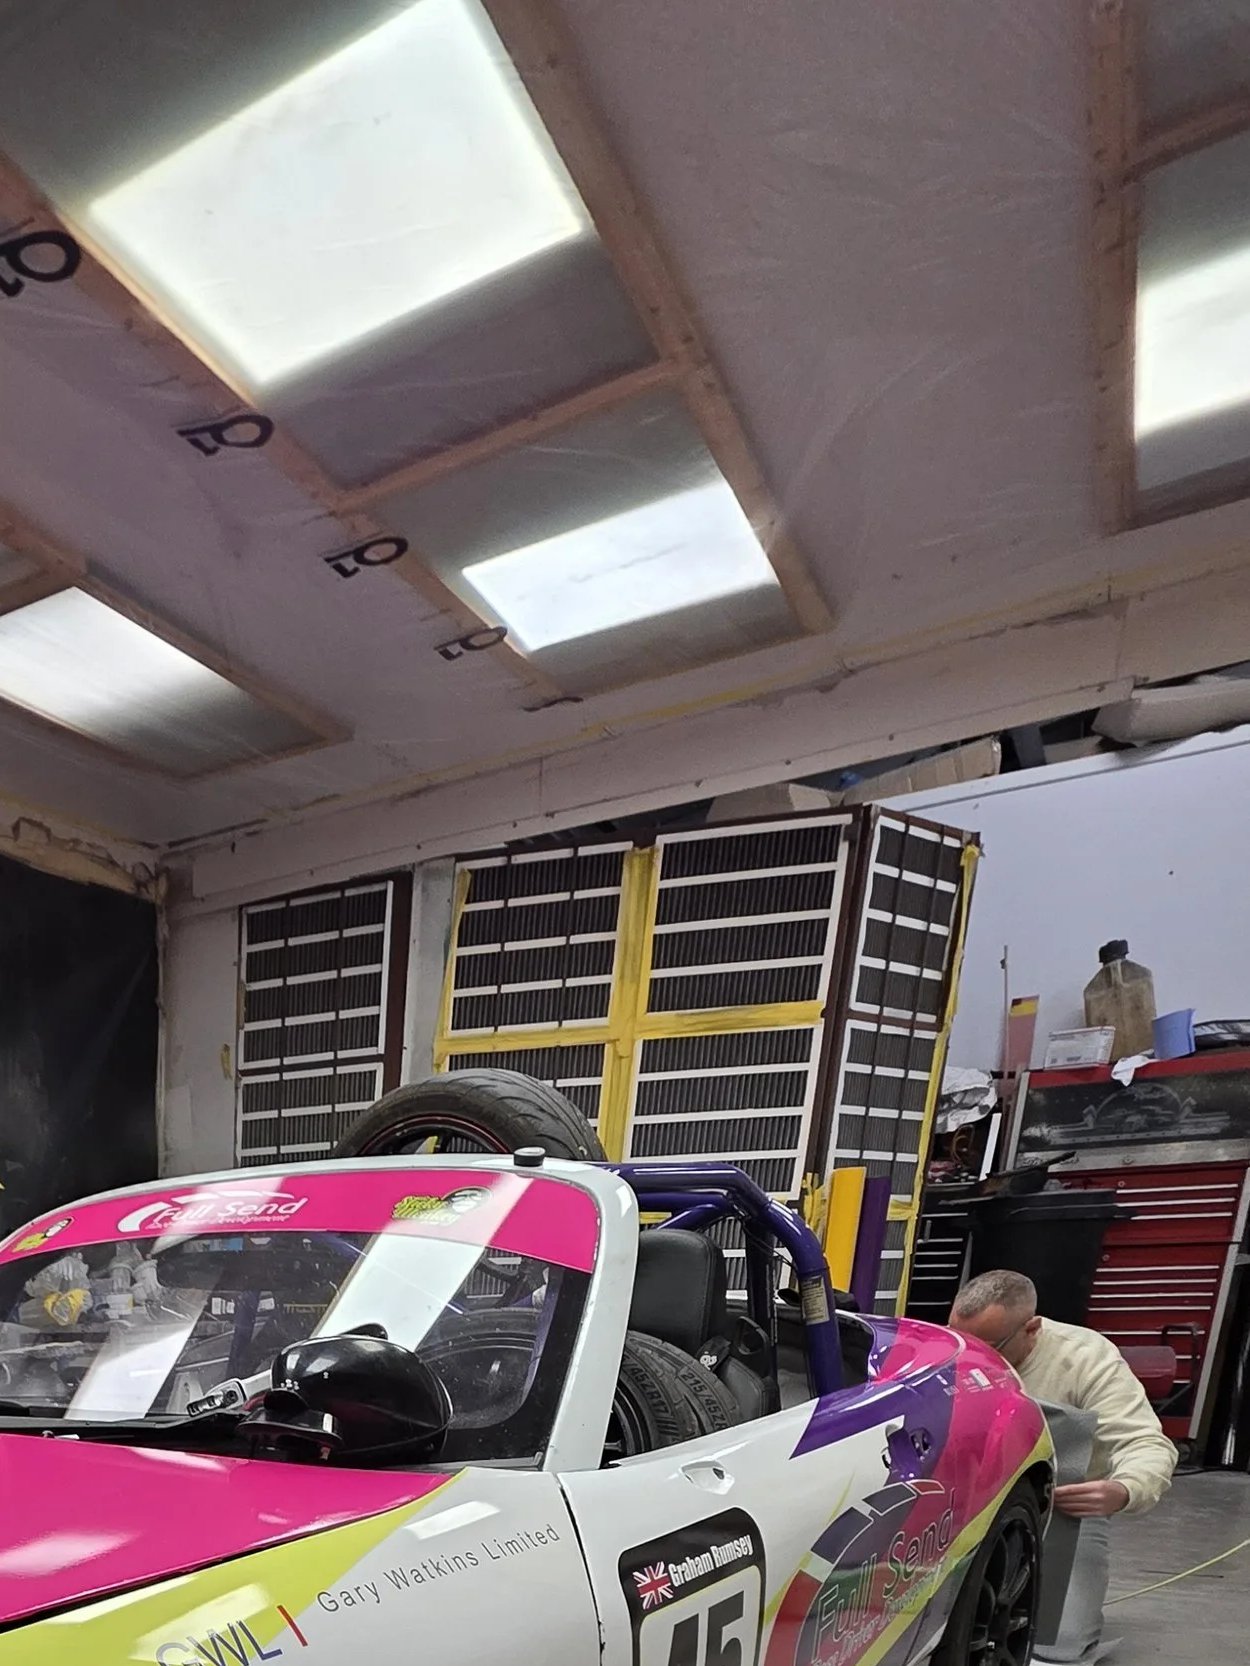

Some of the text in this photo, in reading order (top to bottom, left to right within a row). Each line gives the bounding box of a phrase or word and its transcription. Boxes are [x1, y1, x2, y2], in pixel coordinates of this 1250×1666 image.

[219, 1197, 308, 1216] Send
[316, 1581, 382, 1614] Gary
[384, 1547, 480, 1591] Watkins
[483, 1523, 561, 1563] Limited
[668, 1534, 754, 1587] Graham Rumsey
[811, 1553, 877, 1664] Full
[883, 1488, 955, 1598] Send
